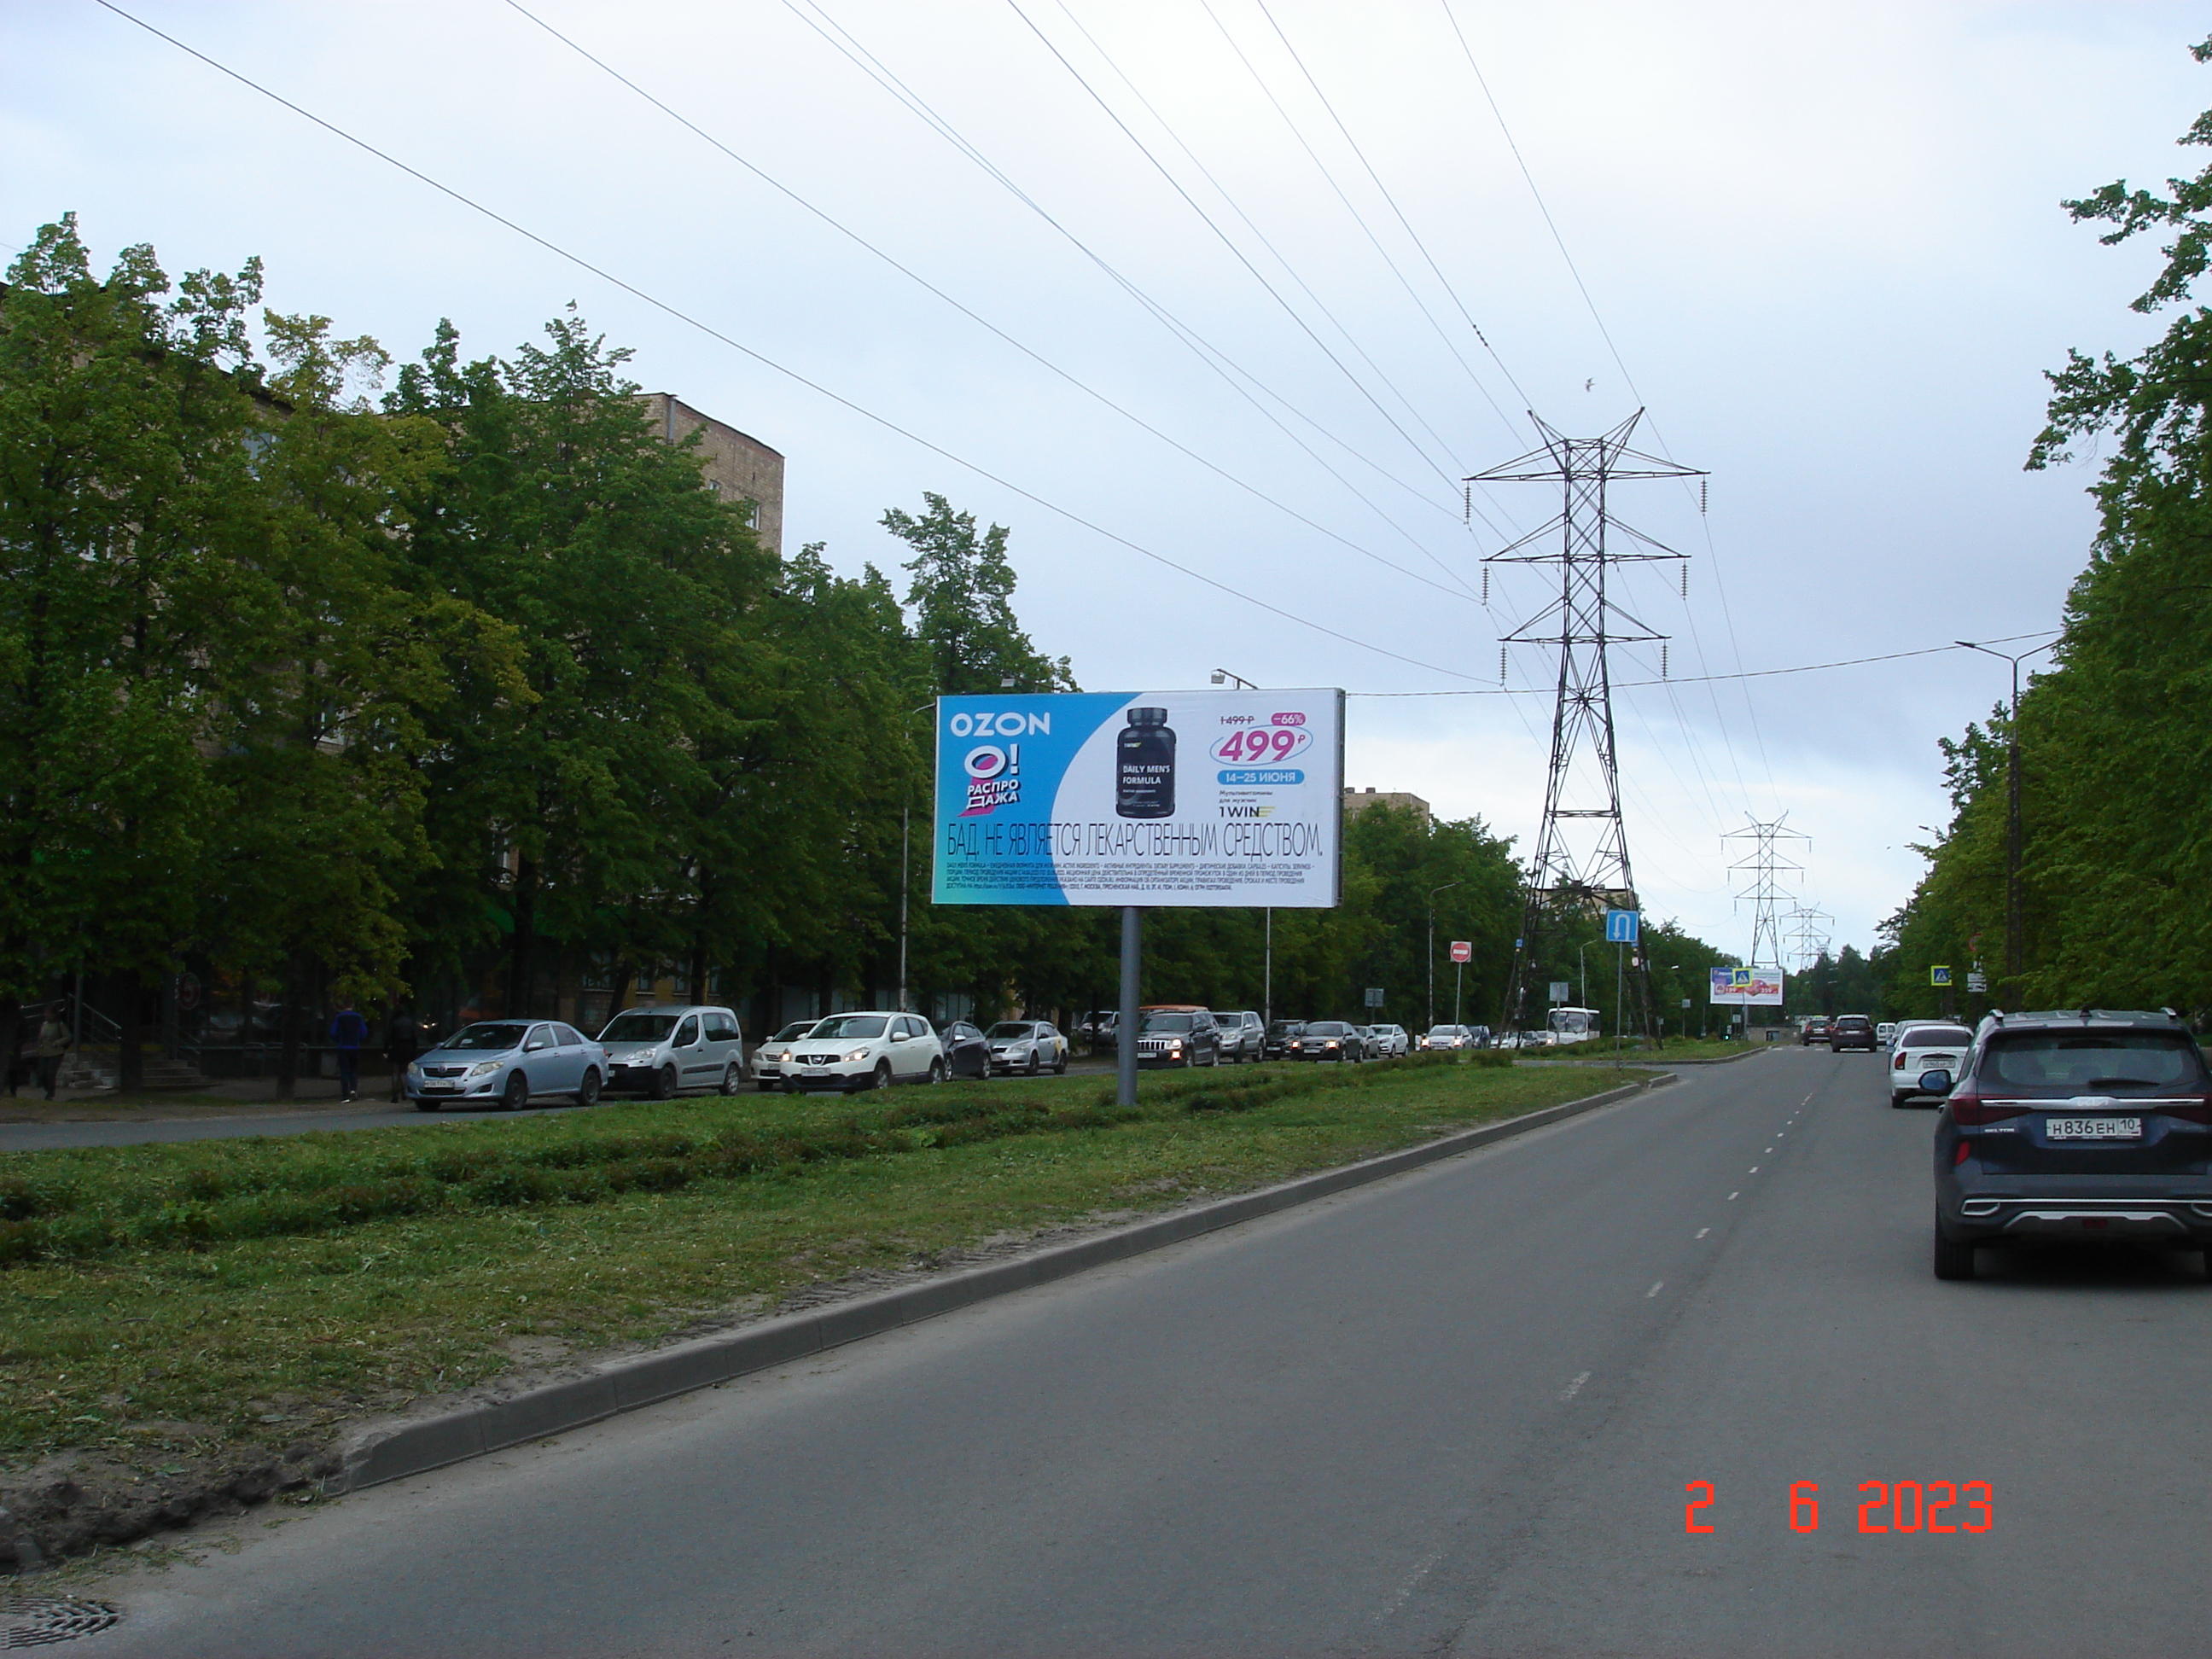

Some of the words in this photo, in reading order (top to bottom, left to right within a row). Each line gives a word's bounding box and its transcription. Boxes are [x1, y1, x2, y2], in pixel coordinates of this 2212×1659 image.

[951, 712, 1051, 737] OZON
[1273, 714, 1304, 725] -66%
[1219, 731, 1295, 761] 499
[1225, 772, 1256, 783] 14-25
[1259, 771, 1295, 783] ИЮНЯ
[968, 779, 1019, 796] РАСПРО
[966, 790, 1018, 809] ДАЖА
[1220, 806, 1260, 818] 1WIN
[986, 823, 1003, 855] НЕ
[1008, 823, 1081, 856] ЯВЛЯЕТСЯ
[1086, 823, 1218, 856] ЛЕКАРСТВЕННЫМ
[1223, 823, 1323, 862] СРЕДСТВОМ.
[2120, 1119, 2135, 1130] 10
